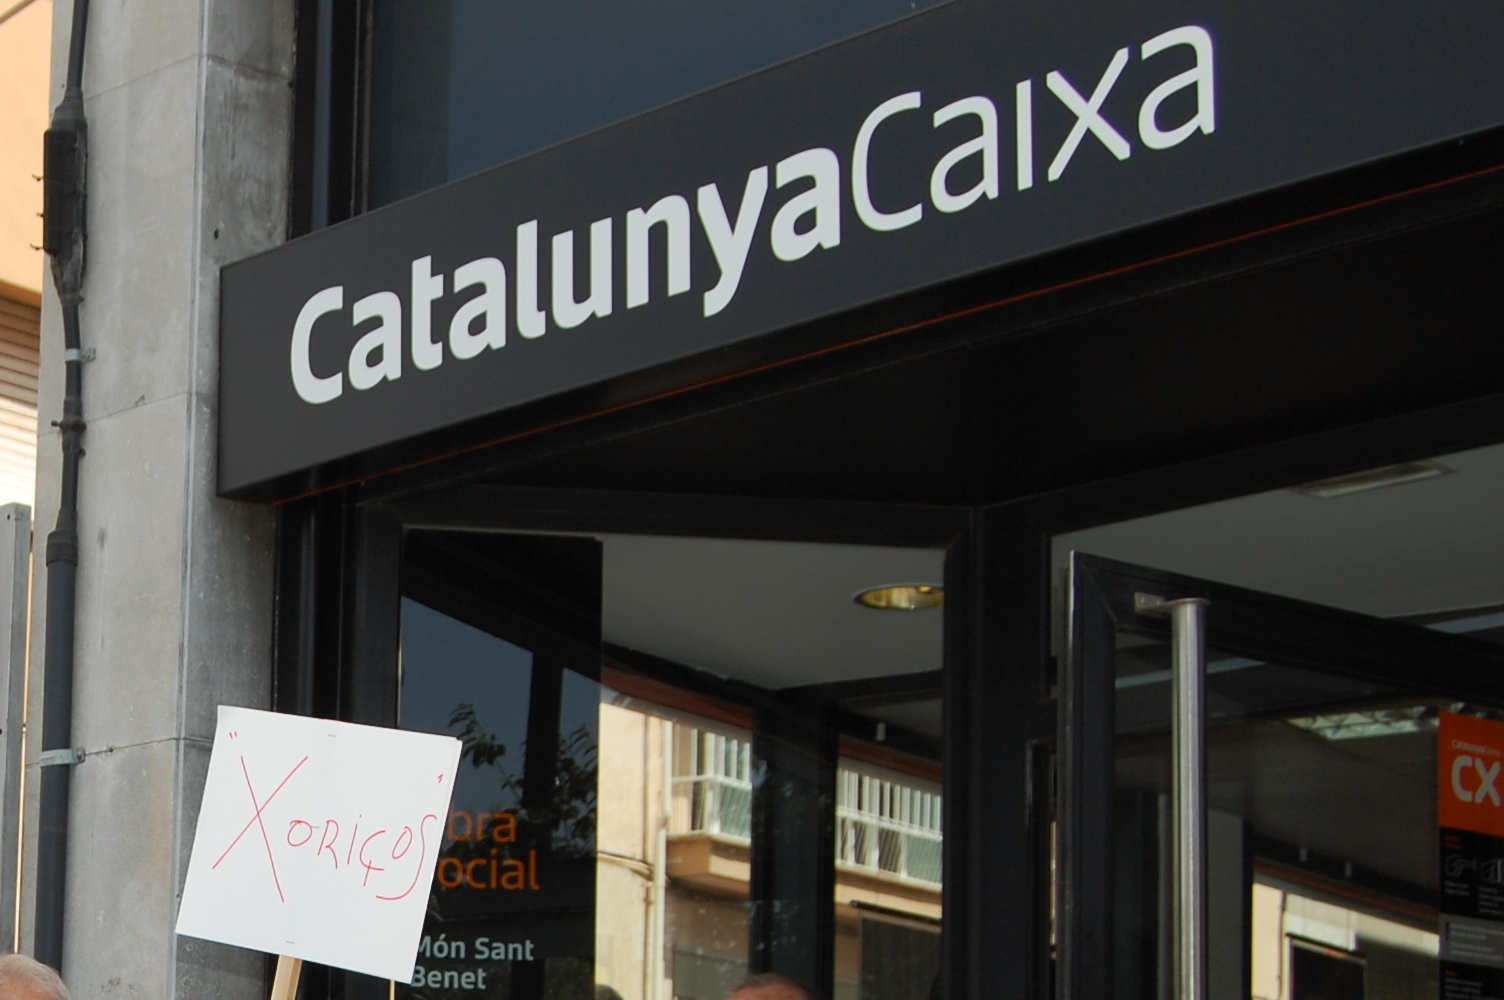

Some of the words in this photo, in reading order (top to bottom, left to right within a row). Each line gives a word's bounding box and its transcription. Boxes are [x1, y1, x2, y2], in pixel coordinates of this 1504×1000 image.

[291, 25, 1215, 404] CatalunyaCaixa
[1451, 754, 1502, 807] CX
[447, 801, 517, 843] bra
[436, 847, 540, 891] ocial
[418, 933, 466, 959] Món
[474, 937, 534, 961] Sant
[411, 965, 487, 990] Benet
